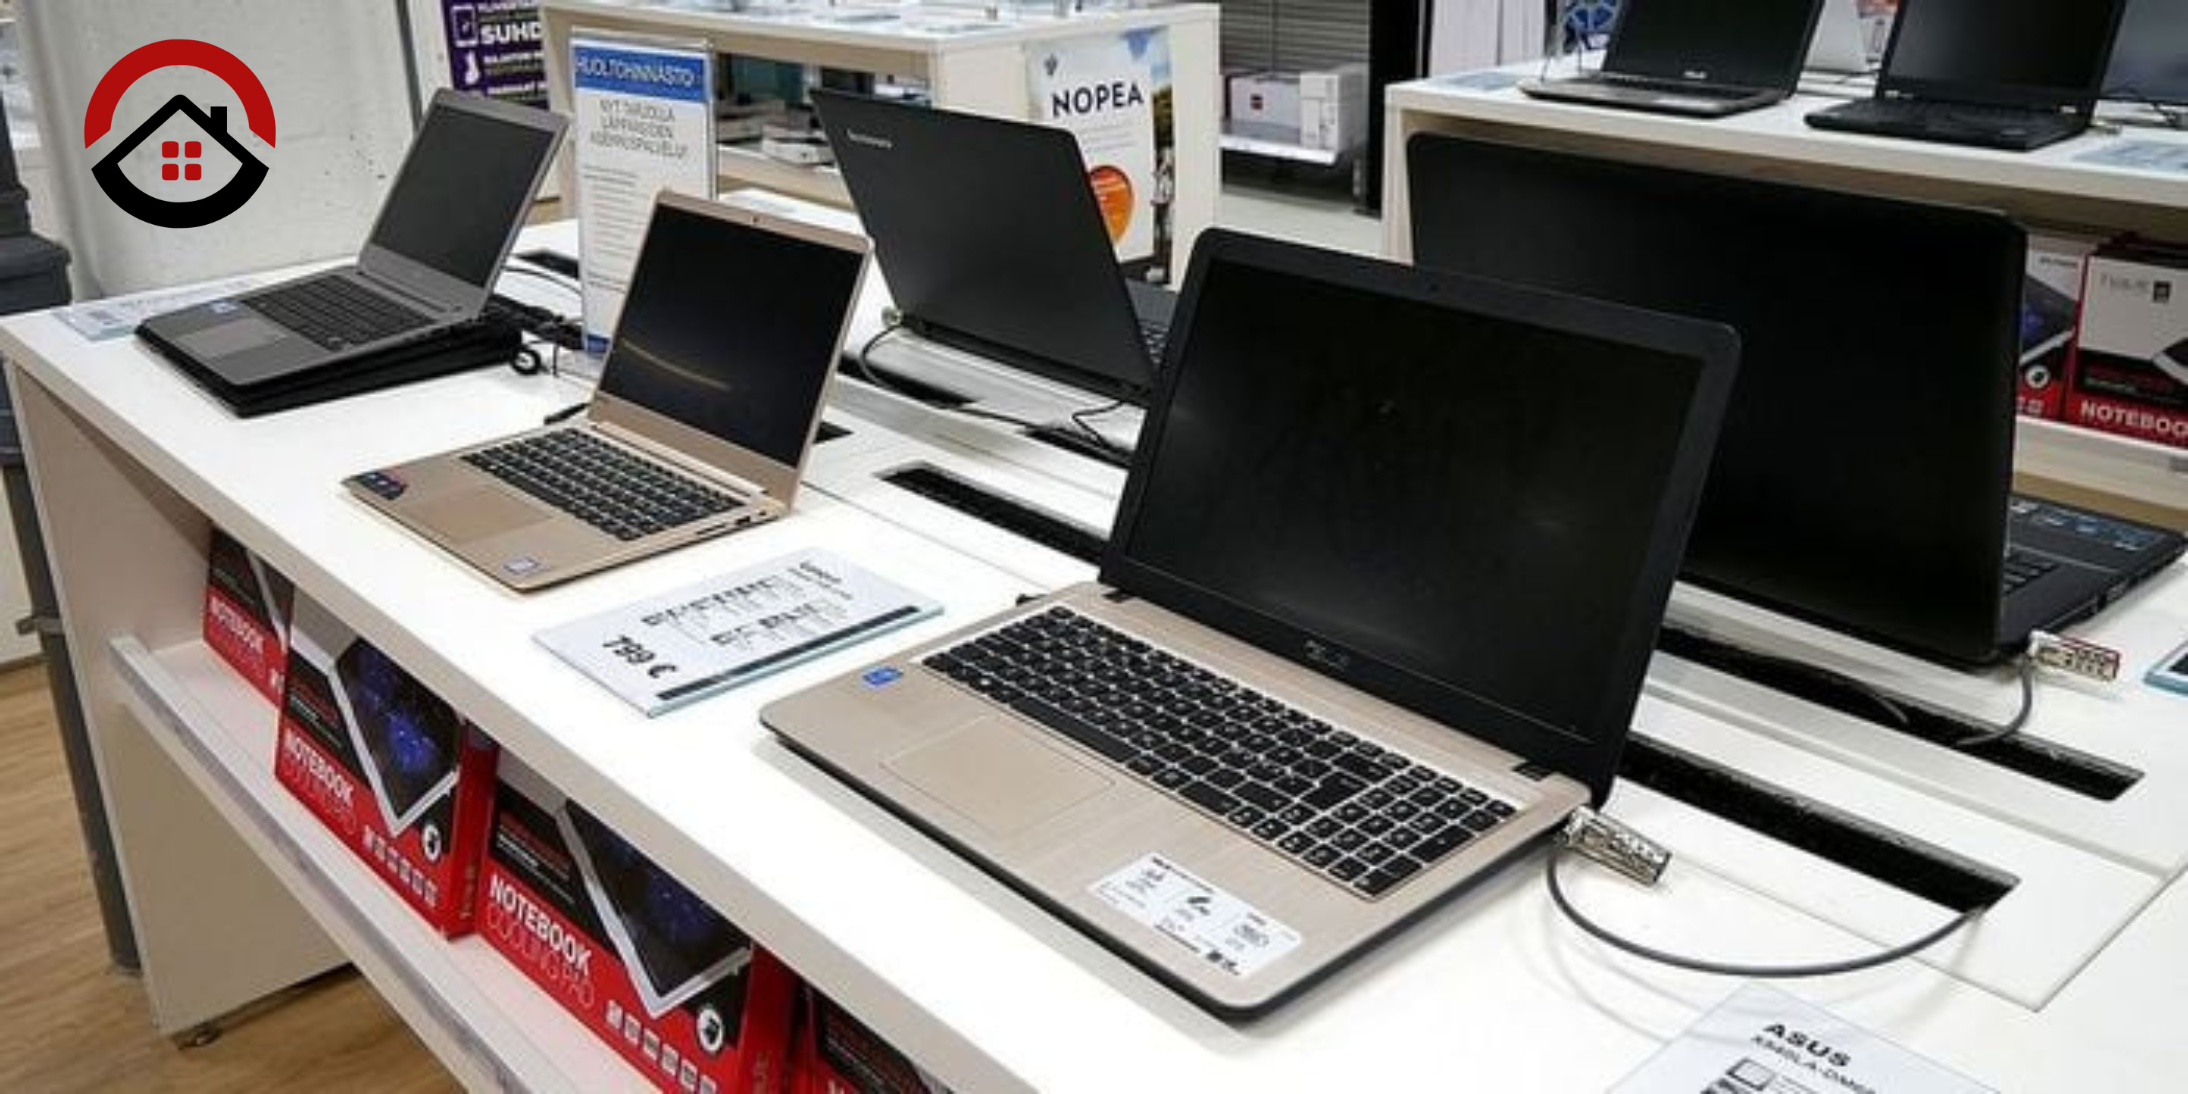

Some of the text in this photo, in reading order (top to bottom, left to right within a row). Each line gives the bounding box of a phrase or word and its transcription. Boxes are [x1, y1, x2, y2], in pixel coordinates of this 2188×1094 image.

[1053, 82, 1144, 118] NOPEA
[209, 595, 264, 654] NOTEBOOK
[602, 633, 677, 679] 799 €
[284, 727, 354, 812] NOTEBOOK
[490, 873, 592, 976] NOTEBOOK
[1762, 1023, 1851, 1067] ASUS
